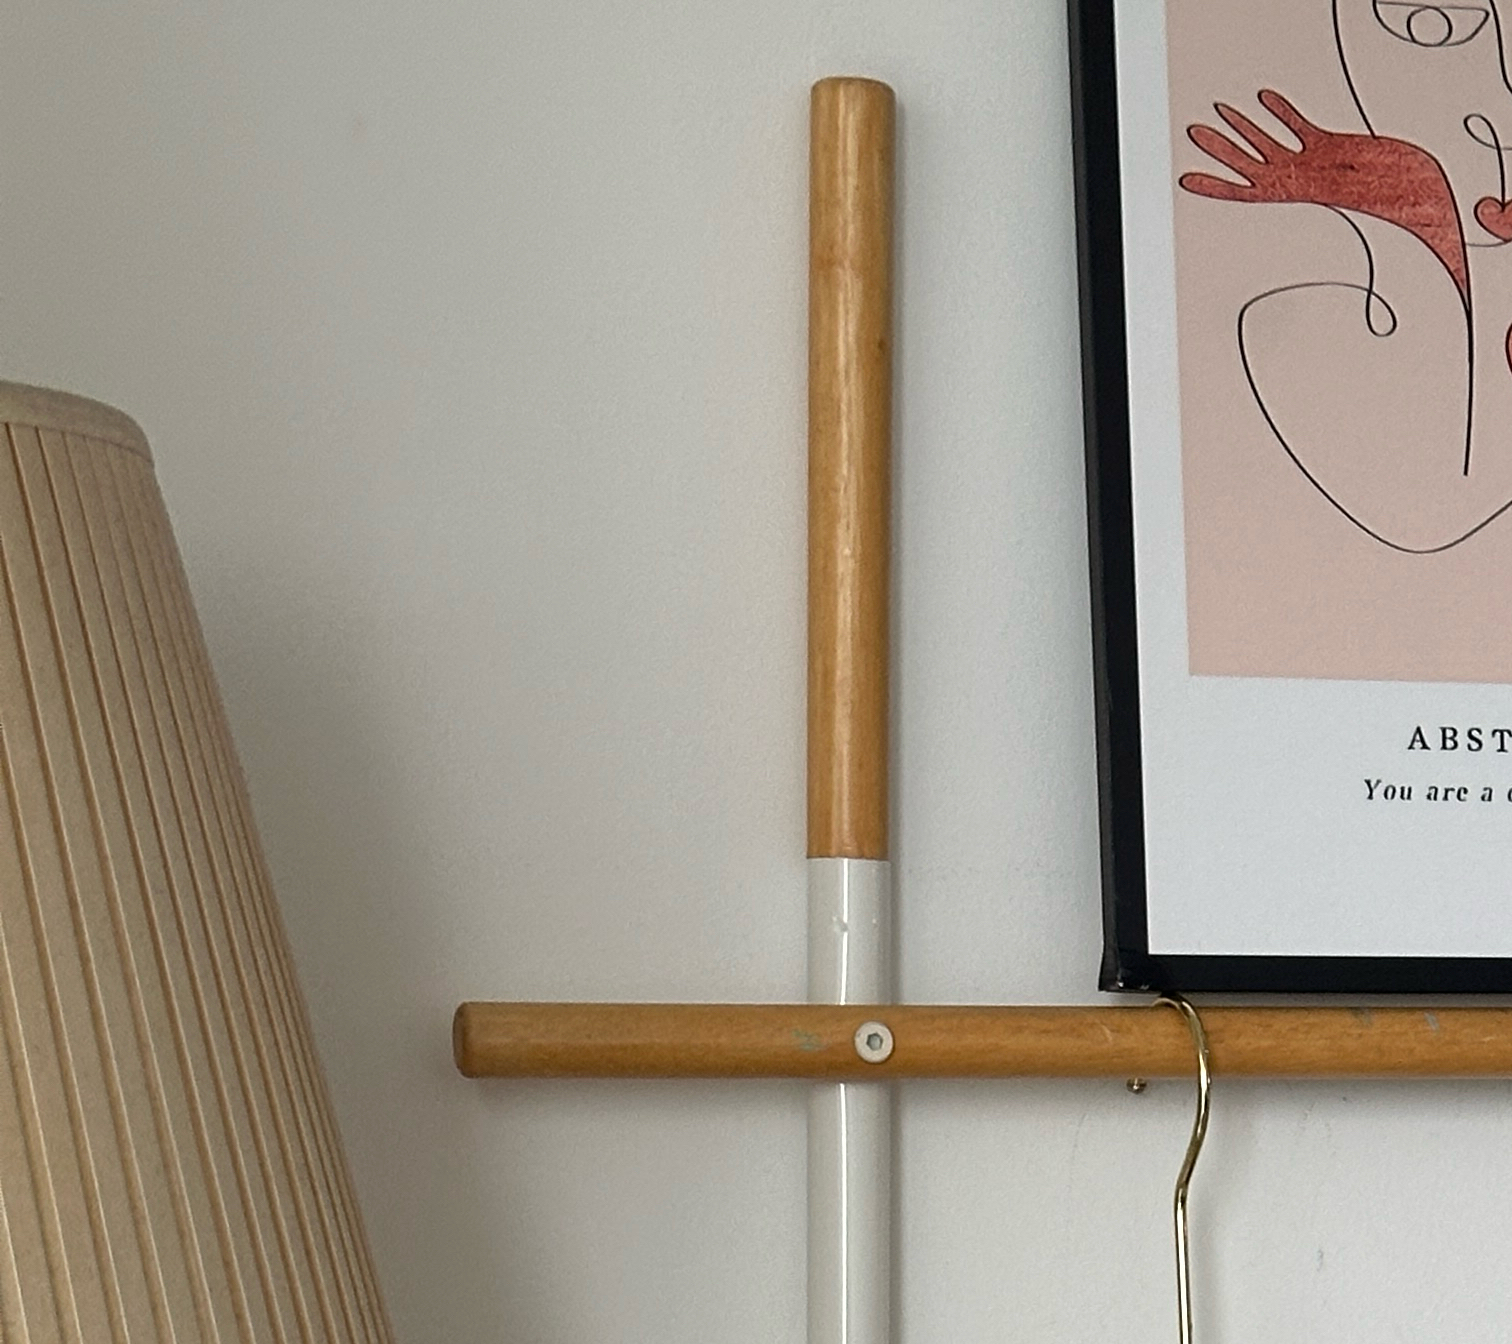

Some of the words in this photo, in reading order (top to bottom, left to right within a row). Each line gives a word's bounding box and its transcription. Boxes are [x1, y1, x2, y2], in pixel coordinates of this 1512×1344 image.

[1364, 779, 1413, 801] You
[1426, 785, 1469, 802] are
[1480, 786, 1494, 802] a
